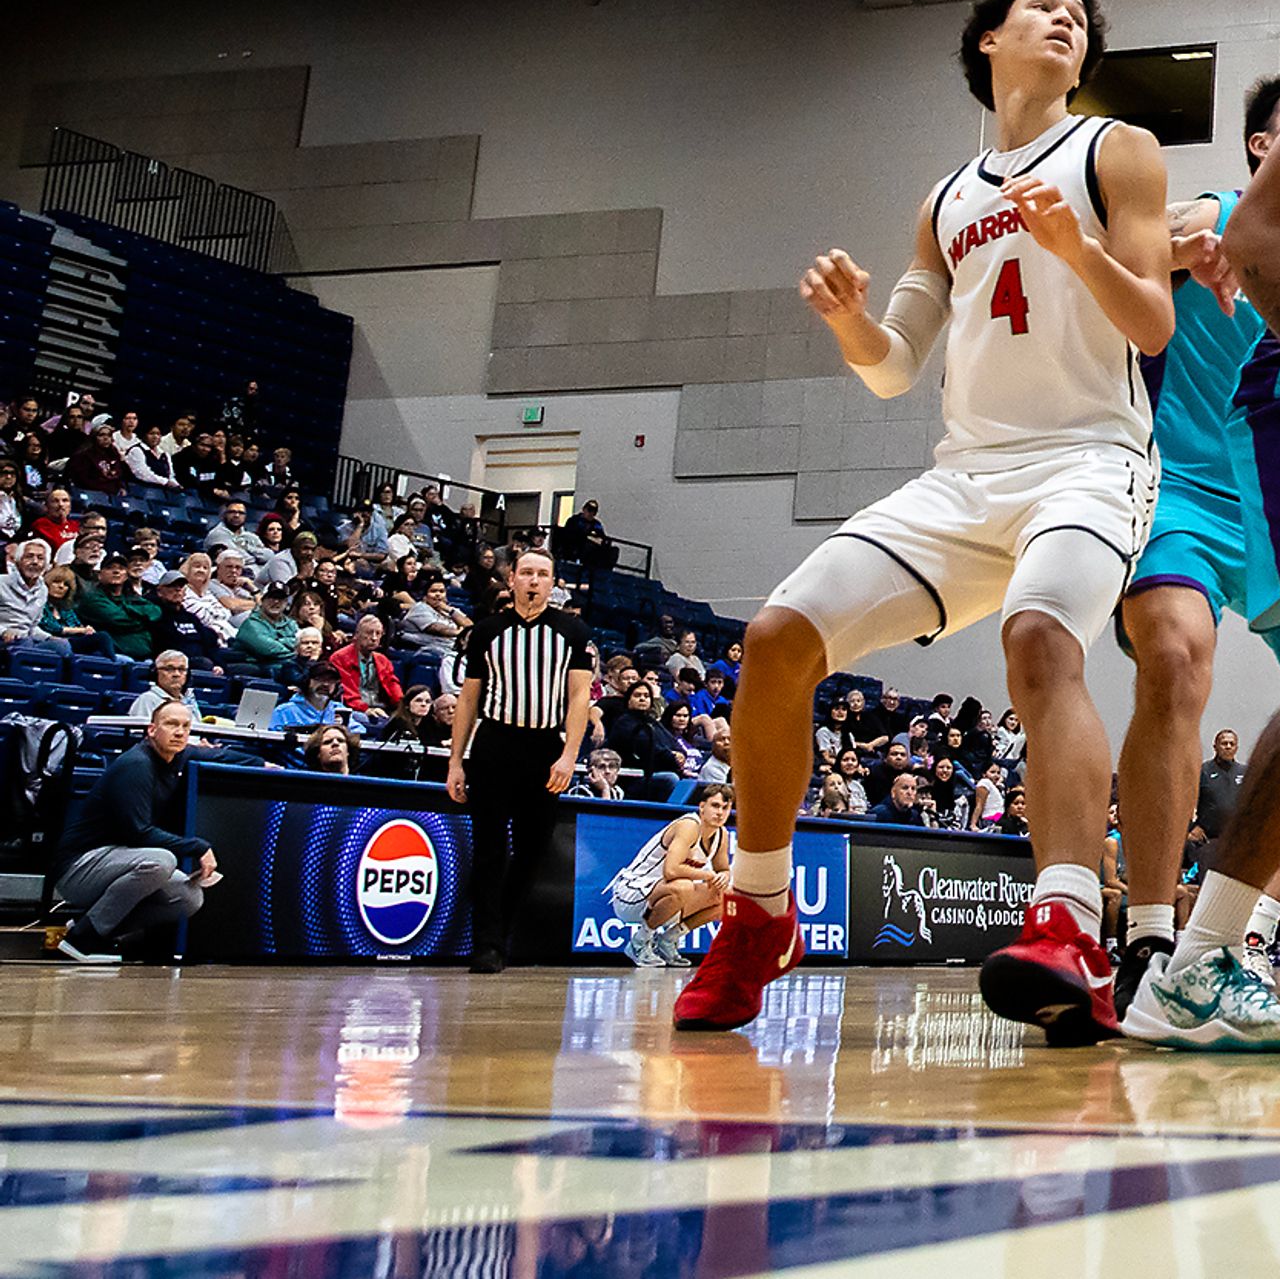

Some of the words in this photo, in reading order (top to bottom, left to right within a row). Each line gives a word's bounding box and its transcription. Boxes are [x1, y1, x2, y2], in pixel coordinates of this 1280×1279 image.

[948, 207, 1031, 270] WARRI
[991, 258, 1030, 335] 4
[496, 493, 506, 511] A
[363, 868, 433, 895] PEPSI
[919, 868, 997, 899] Clearwater
[998, 872, 1035, 908] River
[931, 907, 974, 924] CASINO
[976, 904, 988, 931] &
[988, 910, 1025, 926] LODGE
